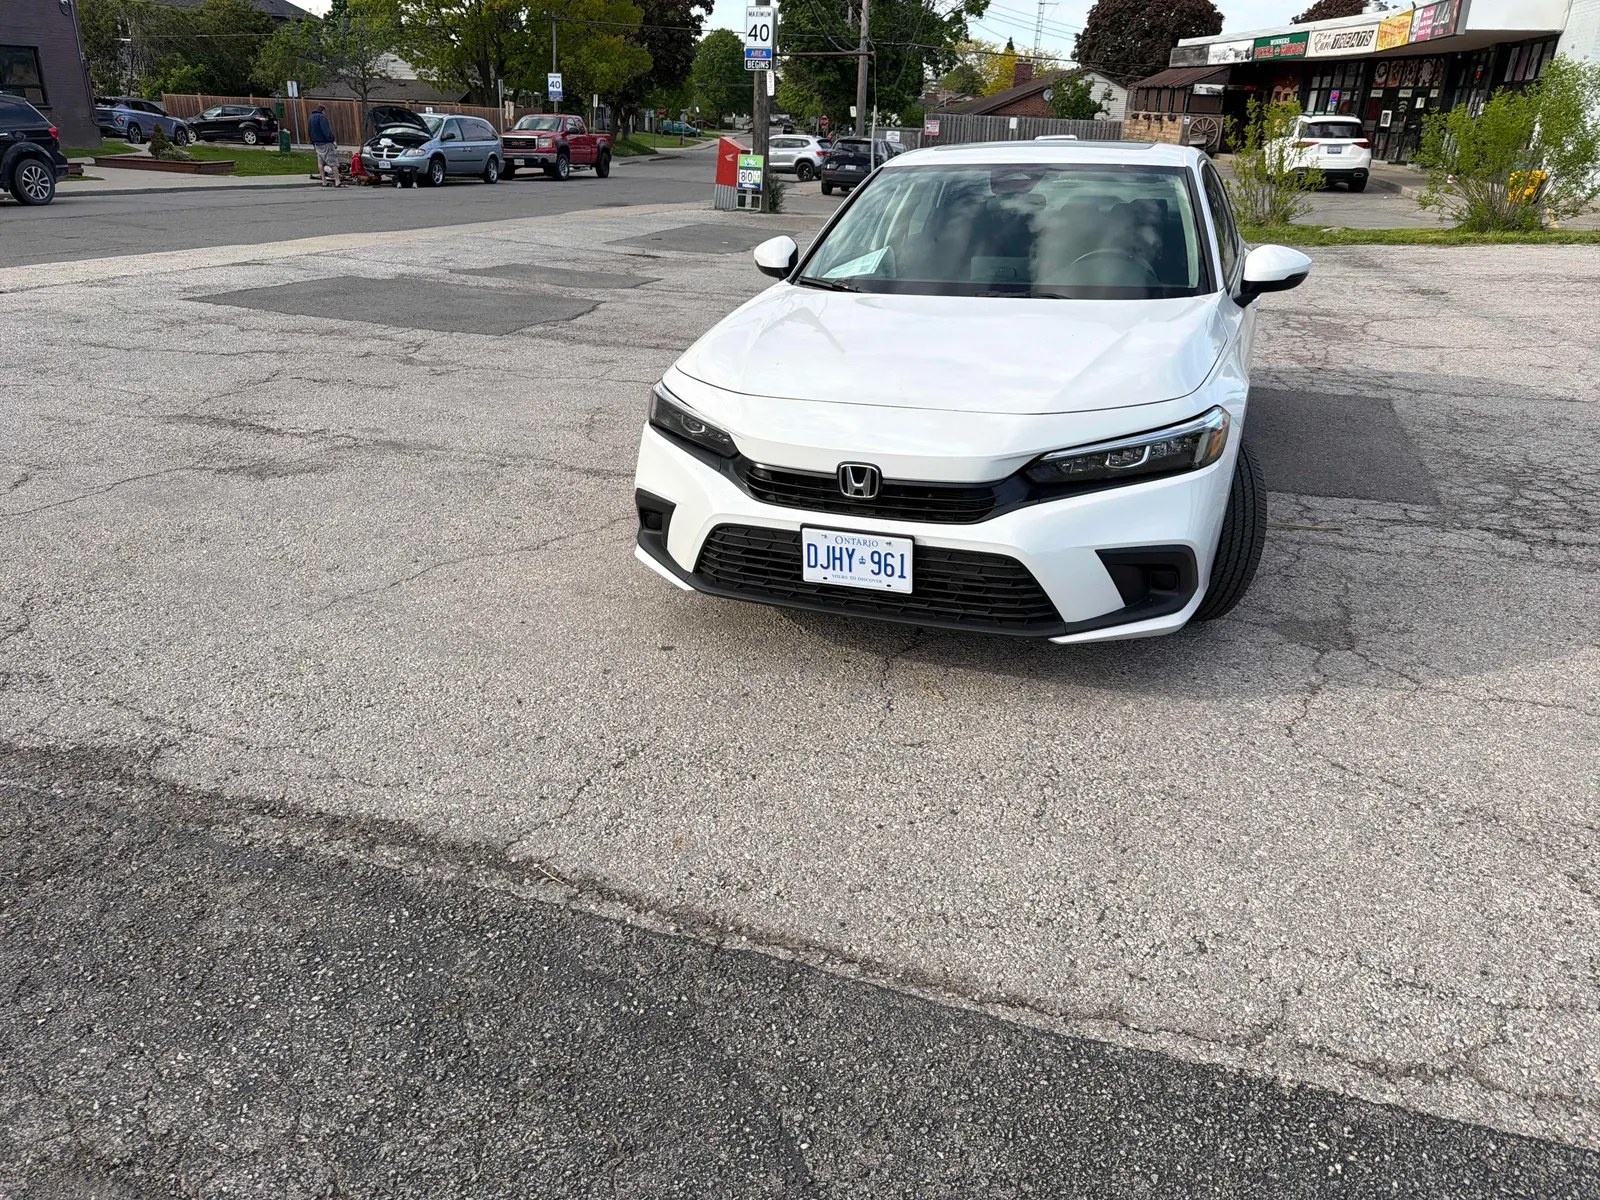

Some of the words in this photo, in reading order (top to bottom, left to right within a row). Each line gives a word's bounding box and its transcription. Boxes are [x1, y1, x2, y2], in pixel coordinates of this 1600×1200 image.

[747, 24, 770, 42] 40
[1330, 30, 1375, 50] TREATS
[1254, 46, 1274, 59] PIZZA
[1280, 42, 1306, 57] WINGS
[747, 60, 770, 69] BEGINS
[549, 80, 561, 89] 40
[806, 542, 856, 573] DJHY
[870, 550, 907, 580] 961
[857, 576, 883, 584] DISCOVER
